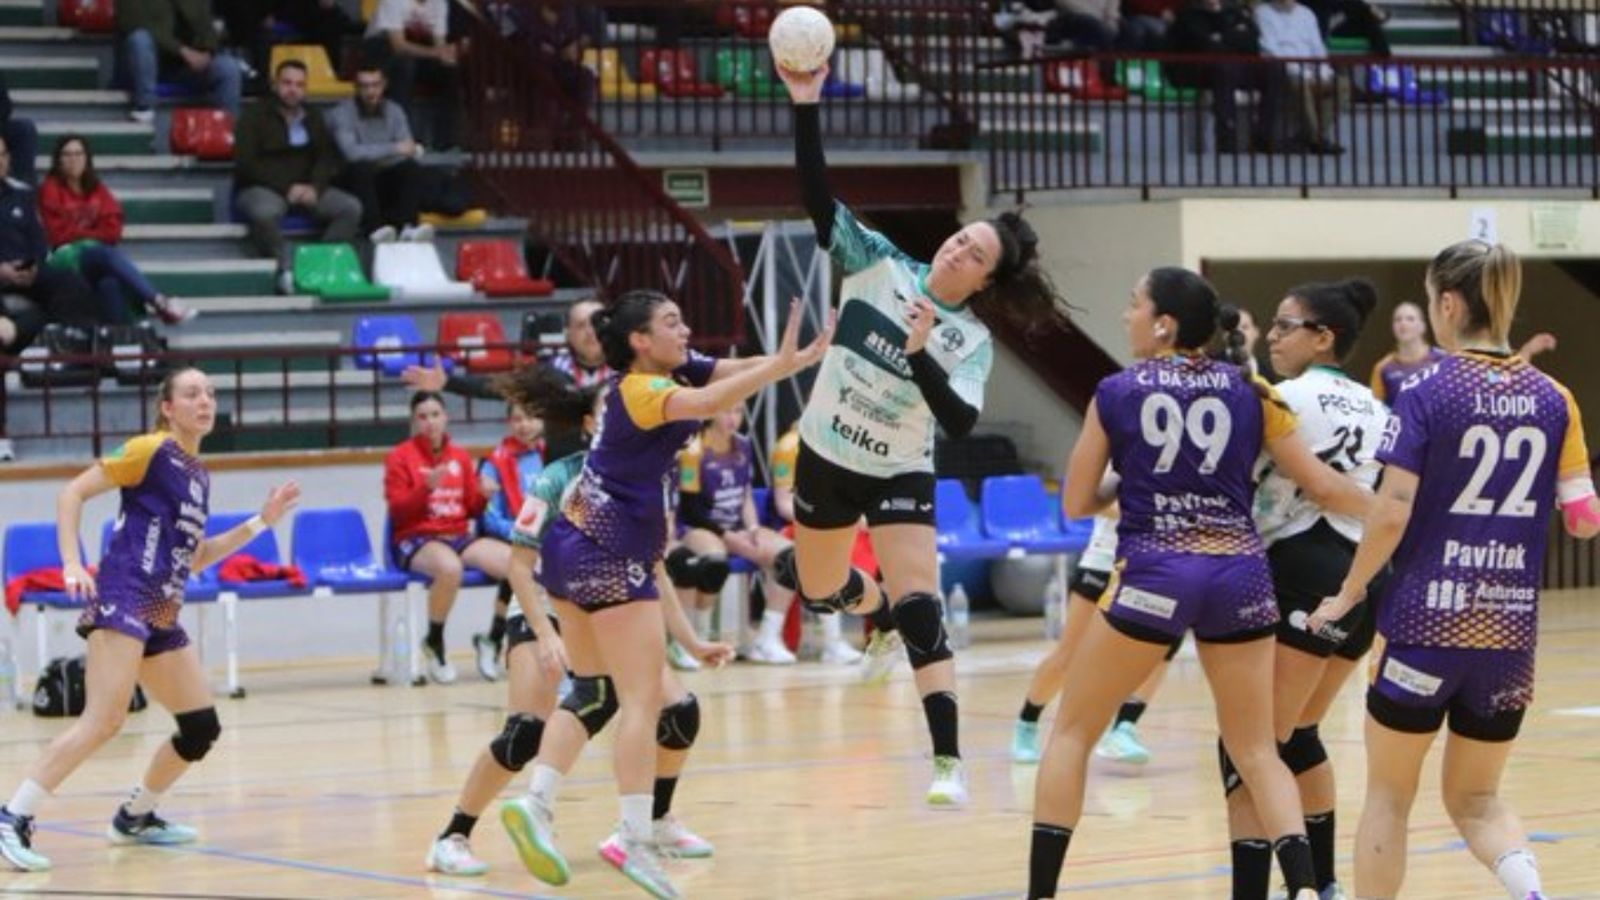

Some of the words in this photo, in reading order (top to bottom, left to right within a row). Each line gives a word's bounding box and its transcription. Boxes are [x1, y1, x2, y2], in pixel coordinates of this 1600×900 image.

[1159, 371, 1183, 387] DA
[1187, 373, 1231, 389] SILVA
[1490, 395, 1538, 416] LOIDI
[831, 414, 890, 457] teika
[1141, 392, 1232, 474] 99
[1449, 424, 1548, 517] 22
[1443, 540, 1526, 570] Pavitek
[1474, 579, 1536, 600] Asturias
